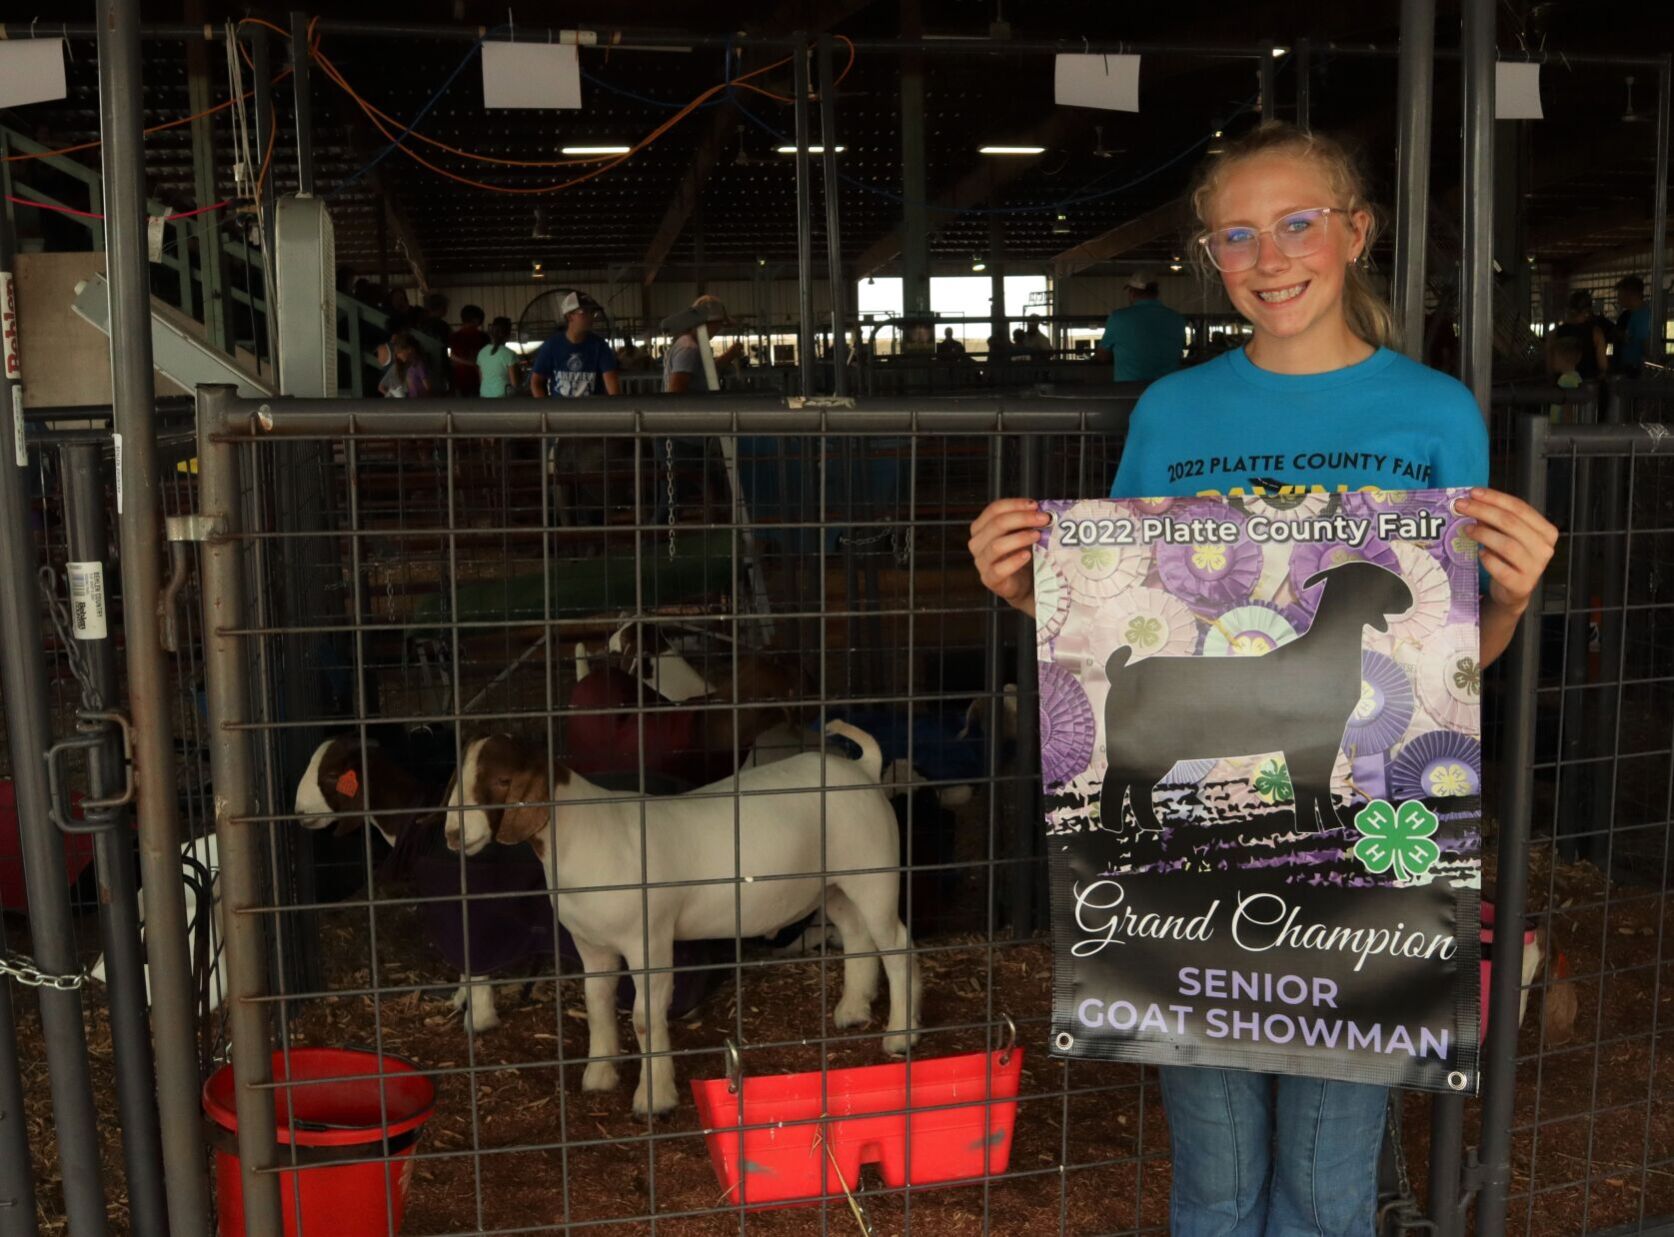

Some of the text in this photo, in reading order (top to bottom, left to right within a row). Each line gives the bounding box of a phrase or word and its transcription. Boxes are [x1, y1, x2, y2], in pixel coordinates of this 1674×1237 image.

[1167, 452, 1432, 483] 2022 PLATTE COUNTY FAIR
[1060, 511, 1445, 547] 2022 Platte County Fair
[1071, 880, 1458, 972] Grand Champion
[1178, 966, 1338, 1008] SENIOR
[1078, 998, 1449, 1060] GOAT SHOWMAN
